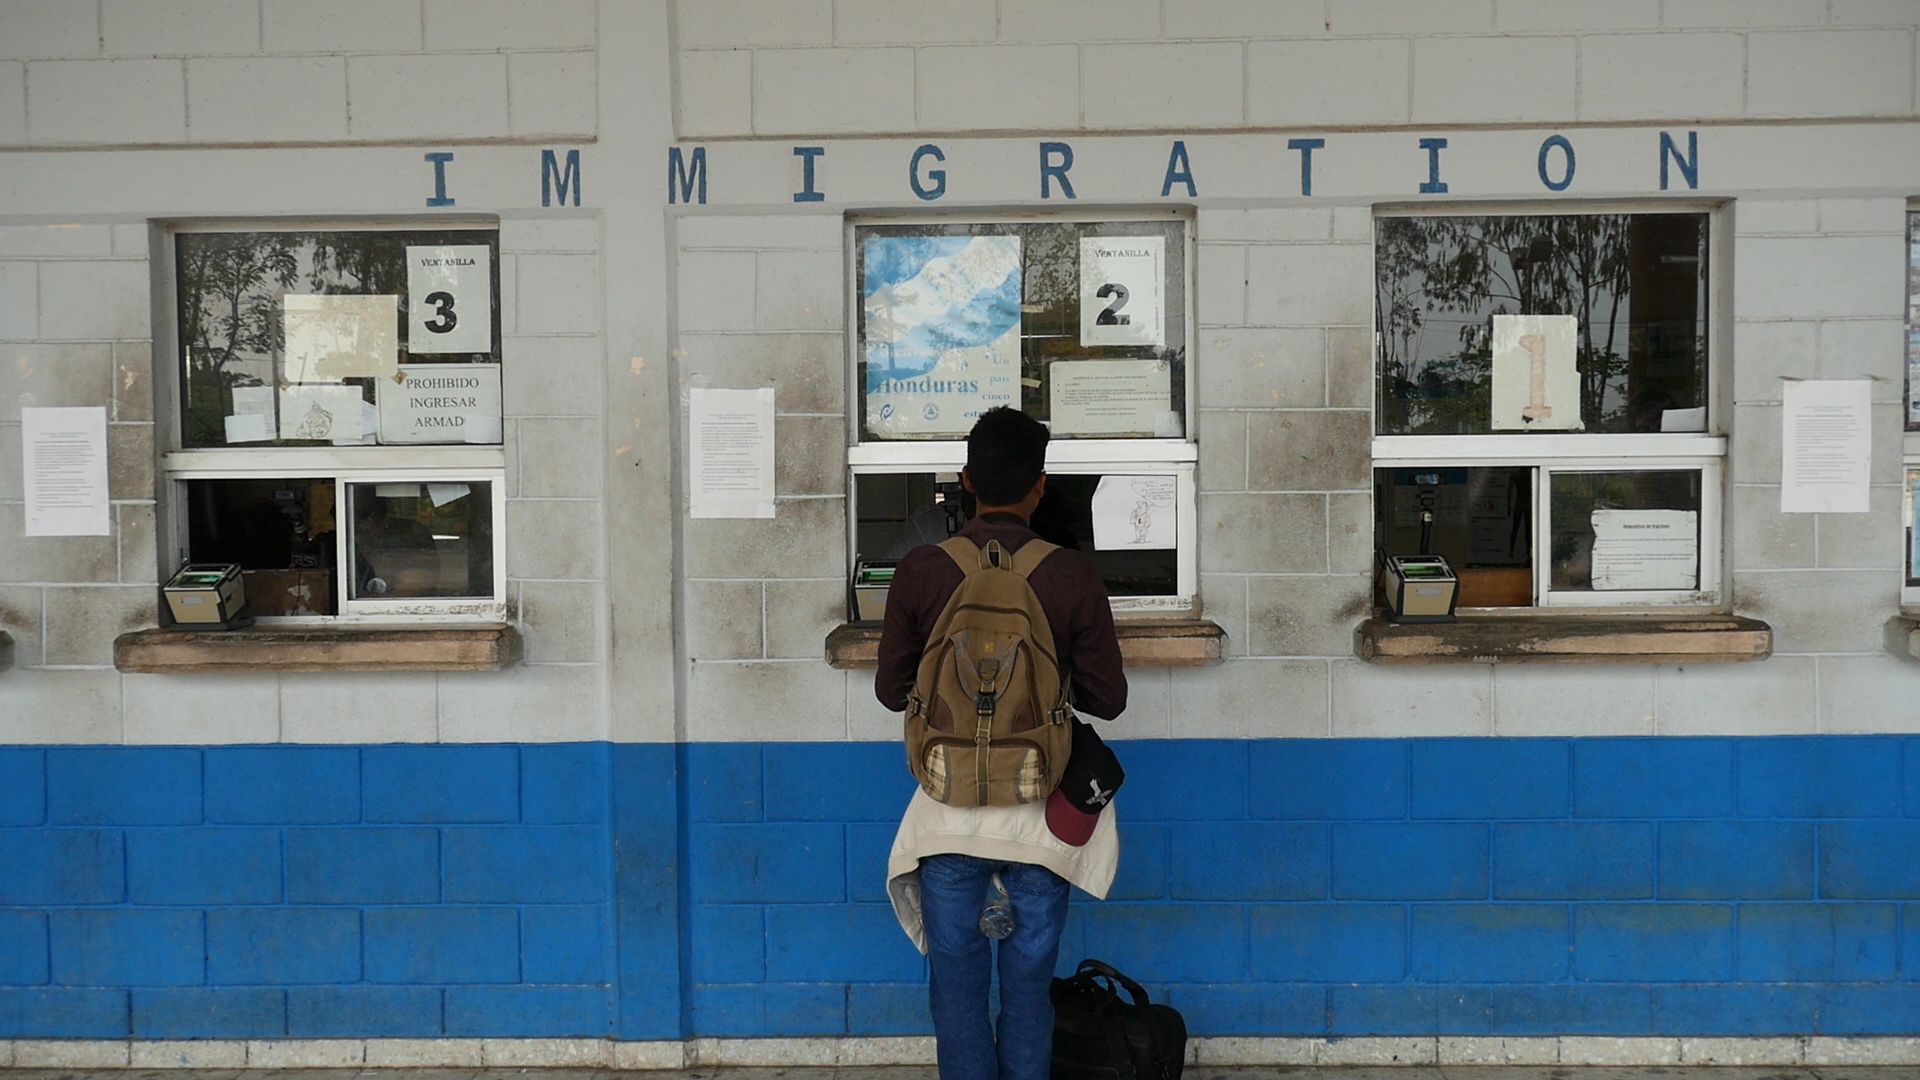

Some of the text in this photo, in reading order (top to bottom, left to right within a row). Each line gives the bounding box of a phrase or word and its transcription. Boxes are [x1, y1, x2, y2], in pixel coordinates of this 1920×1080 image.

[426, 130, 1698, 207] IMMIGRATION
[1096, 283, 1130, 325] 2
[424, 291, 457, 334] 3
[406, 377, 479, 389] PROHIBIDO
[876, 377, 978, 393] Honduras
[1519, 335, 1552, 419] 1
[410, 397, 477, 408] INGRESAR
[982, 391, 1010, 401] cinco
[415, 416, 465, 427] ARMAD
